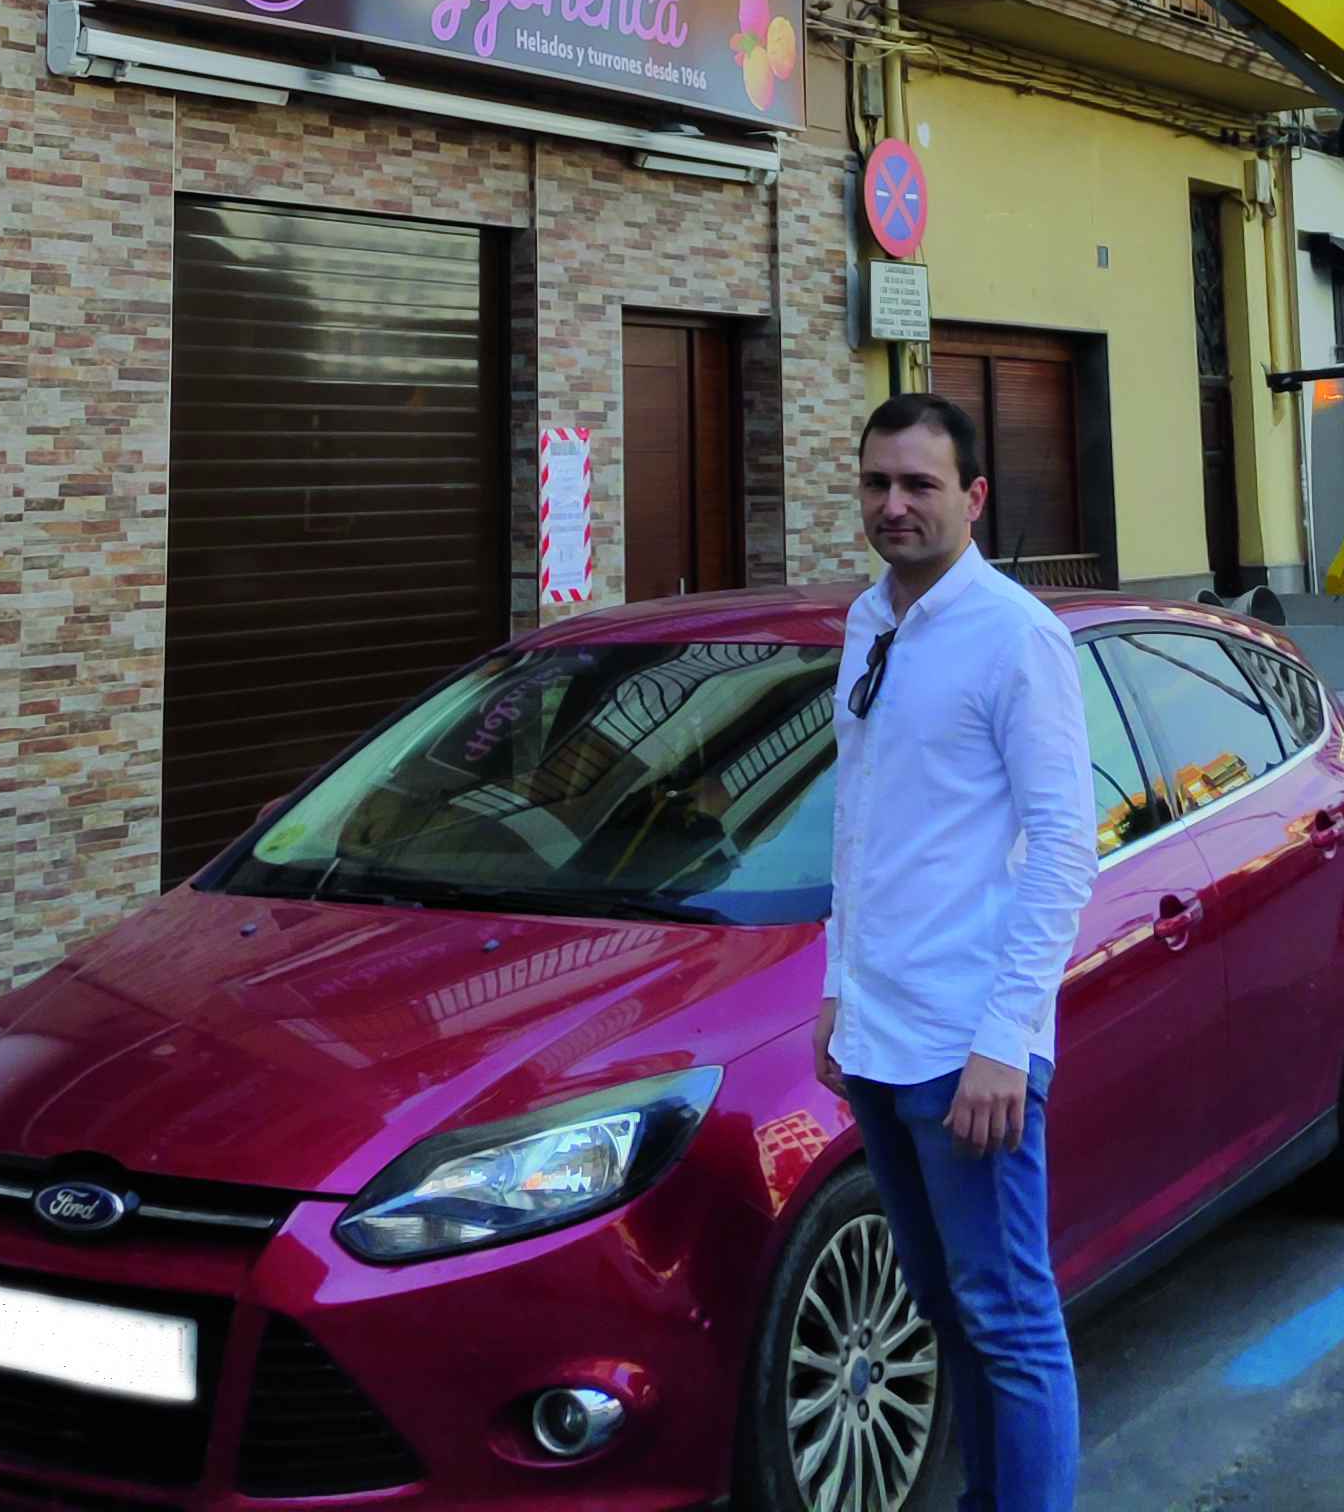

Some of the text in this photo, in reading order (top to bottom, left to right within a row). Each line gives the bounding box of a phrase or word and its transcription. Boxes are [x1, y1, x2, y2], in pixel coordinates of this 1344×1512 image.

[516, 28, 707, 90] Helados y turrones desde 1966
[49, 1188, 100, 1220] Ford
